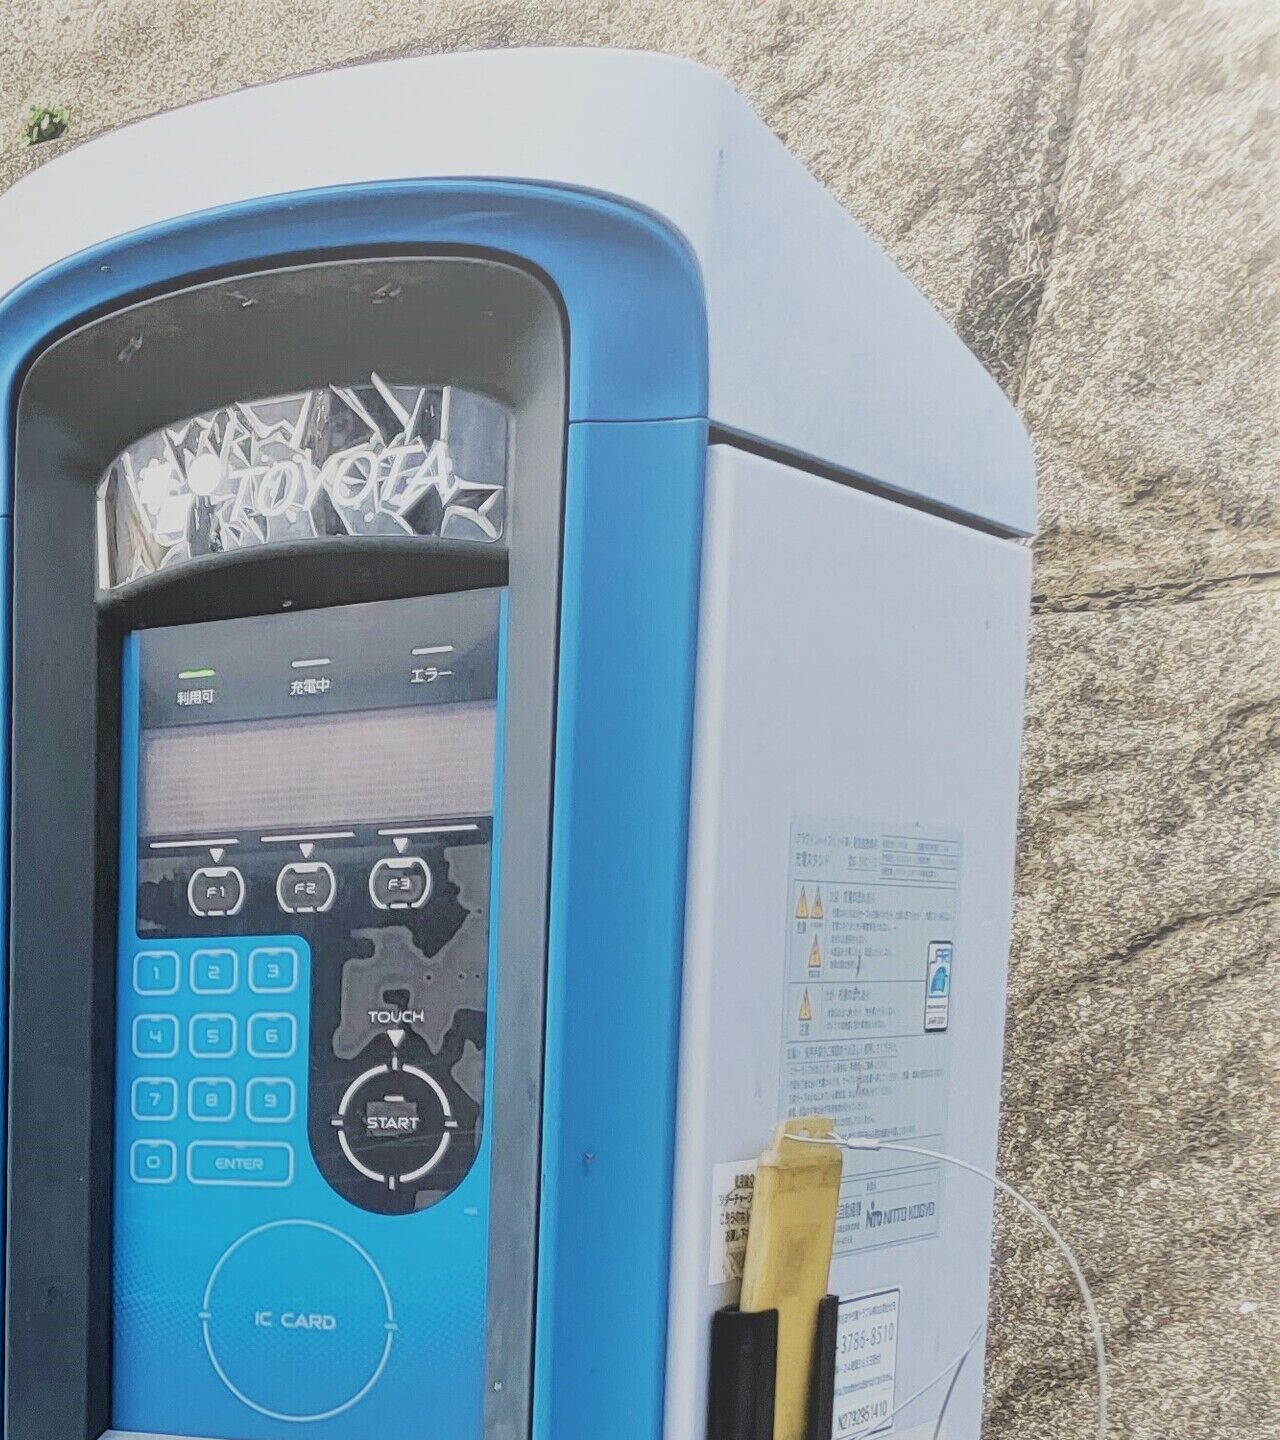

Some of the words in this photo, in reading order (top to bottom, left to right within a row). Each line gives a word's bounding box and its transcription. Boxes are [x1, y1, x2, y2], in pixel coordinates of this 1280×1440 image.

[411, 667, 453, 683] エラー
[290, 678, 331, 696] 充電中
[177, 689, 215, 706] 利用可
[294, 882, 316, 894] F2
[388, 878, 411, 890] F3
[206, 886, 225, 898] F1
[152, 966, 160, 980] 1
[208, 965, 220, 979] 2
[267, 964, 279, 978] 3
[368, 1009, 424, 1023] TOUCH
[149, 1030, 162, 1043] 4
[207, 1029, 219, 1043] 5
[265, 1029, 278, 1043] 6
[149, 1093, 161, 1106] 7
[206, 1093, 218, 1107] 8
[264, 1093, 277, 1107] 9
[367, 1117, 419, 1130] START
[215, 1158, 264, 1170] ENTER
[255, 1311, 272, 1327] IC
[281, 1312, 336, 1330] CARD
